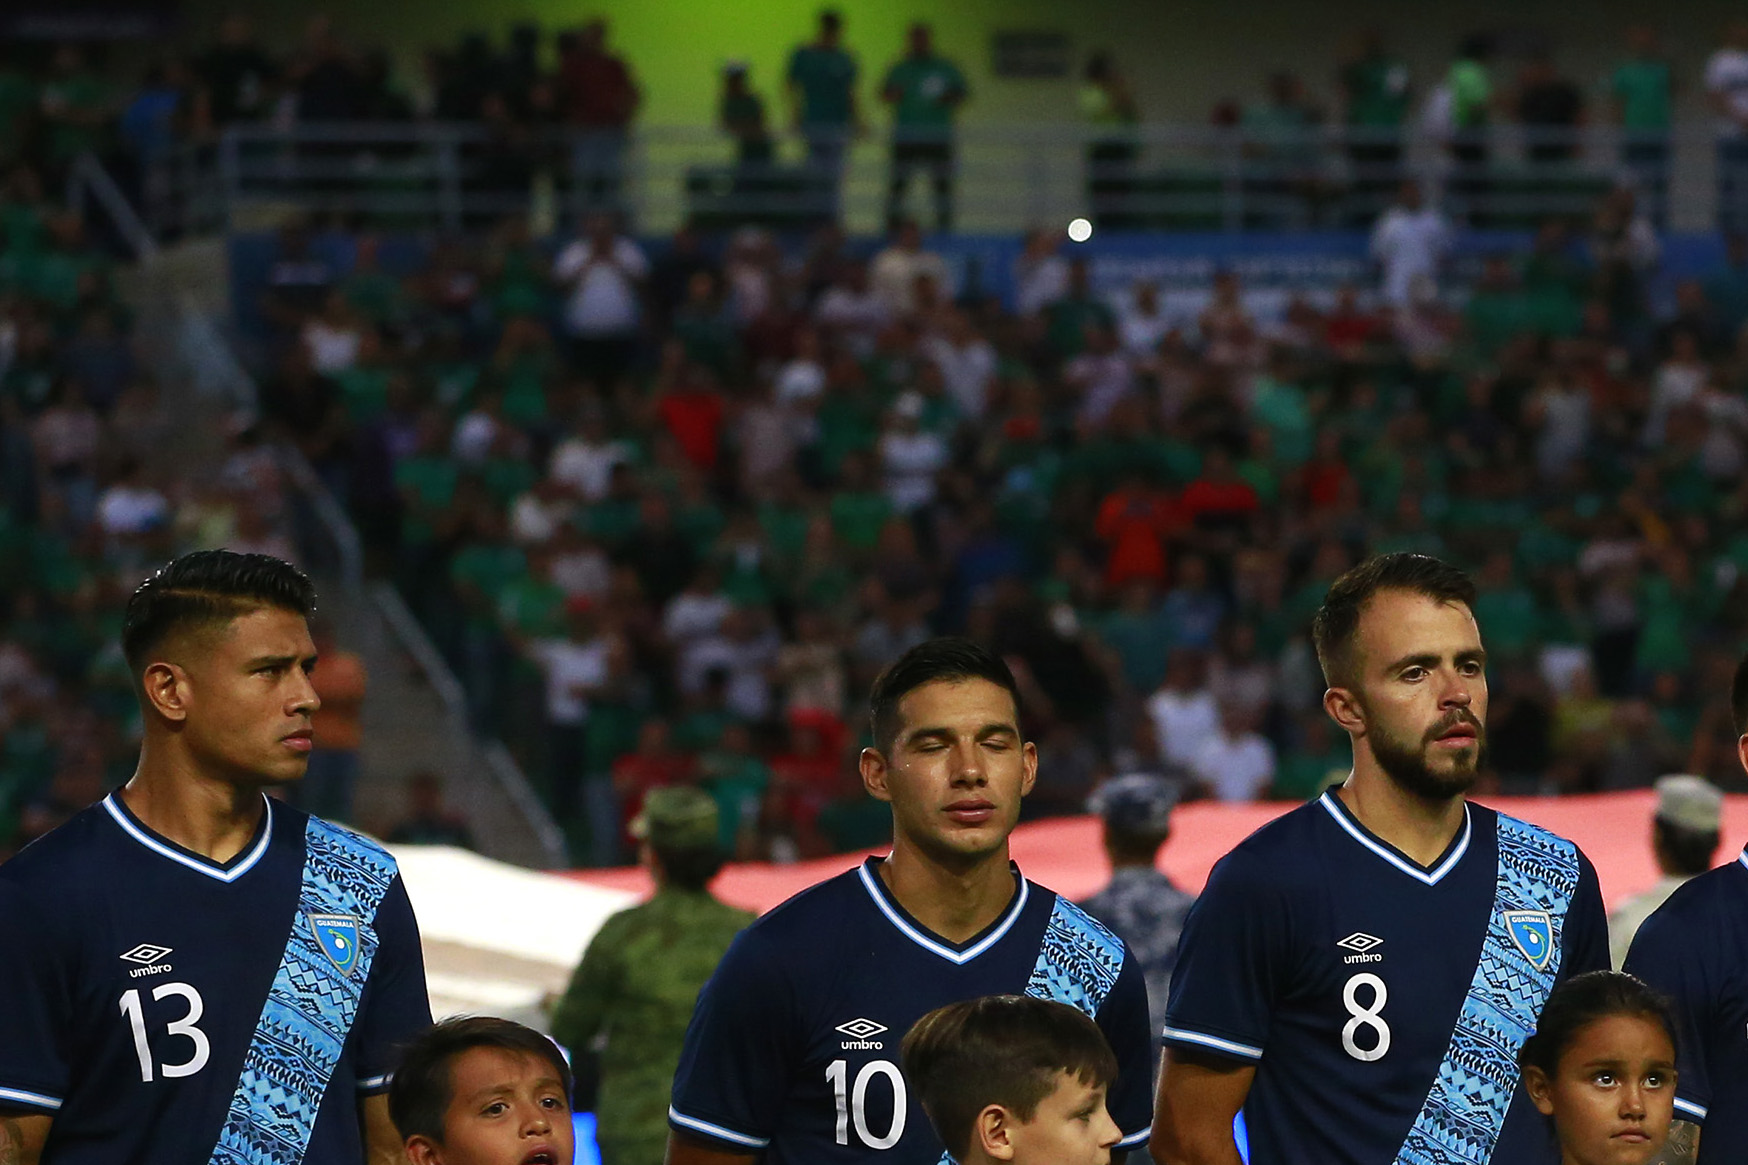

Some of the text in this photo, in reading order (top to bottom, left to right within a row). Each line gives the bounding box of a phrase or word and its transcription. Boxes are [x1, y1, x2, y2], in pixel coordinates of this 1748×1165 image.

[129, 963, 172, 978] umbro
[1343, 952, 1382, 964] umbro
[118, 982, 211, 1082] 13
[1341, 972, 1391, 1062] 8
[840, 1039, 884, 1050] umbro
[825, 1059, 907, 1150] 10
